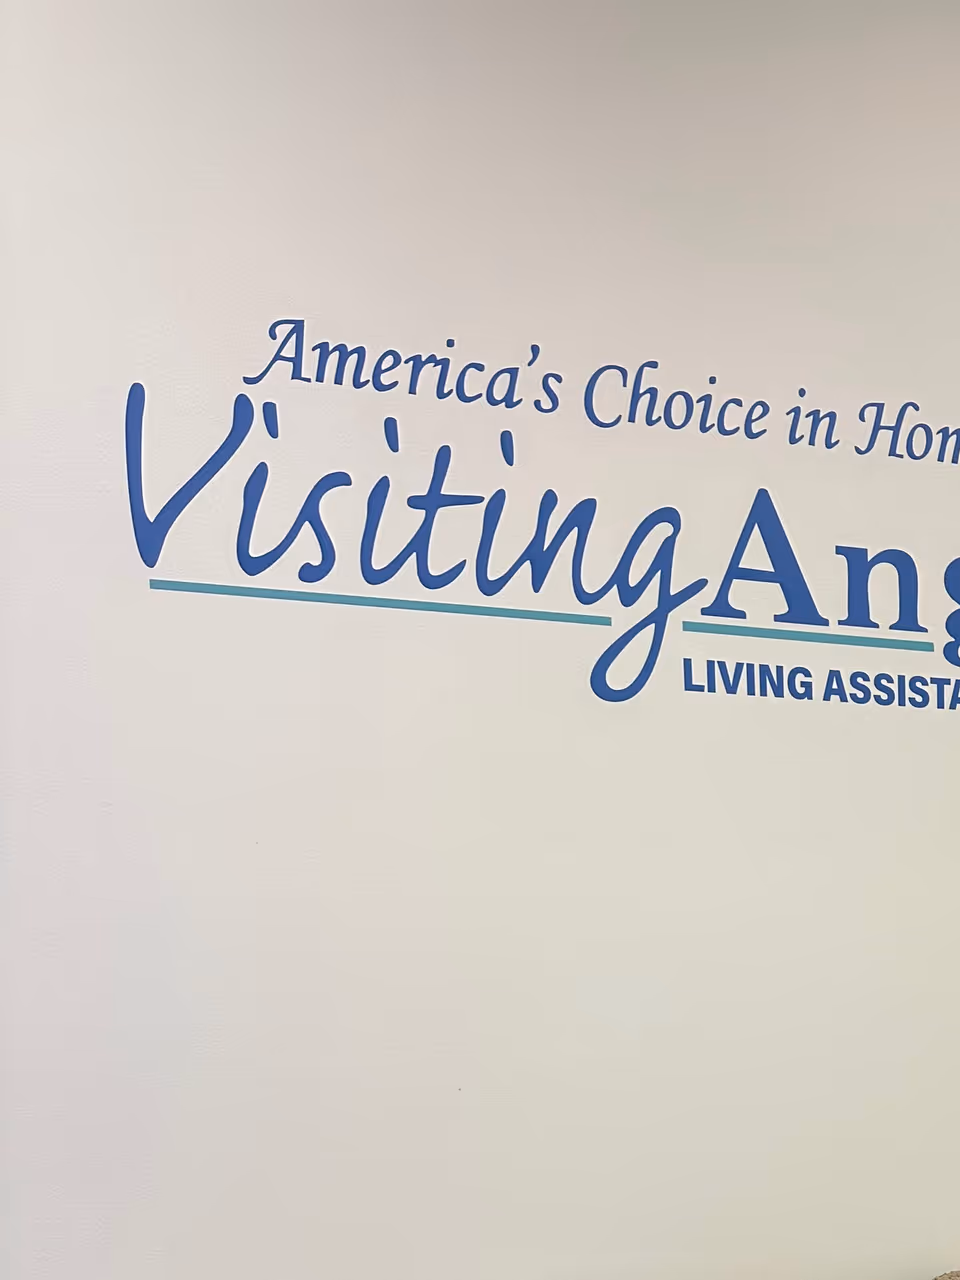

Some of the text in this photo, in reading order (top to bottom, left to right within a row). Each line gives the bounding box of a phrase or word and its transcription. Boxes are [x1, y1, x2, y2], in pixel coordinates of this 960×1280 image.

[243, 319, 562, 414] America's
[583, 361, 770, 440] Choice
[788, 389, 839, 450] in
[125, 382, 709, 703] Visiting
[683, 658, 813, 701] LIVING
